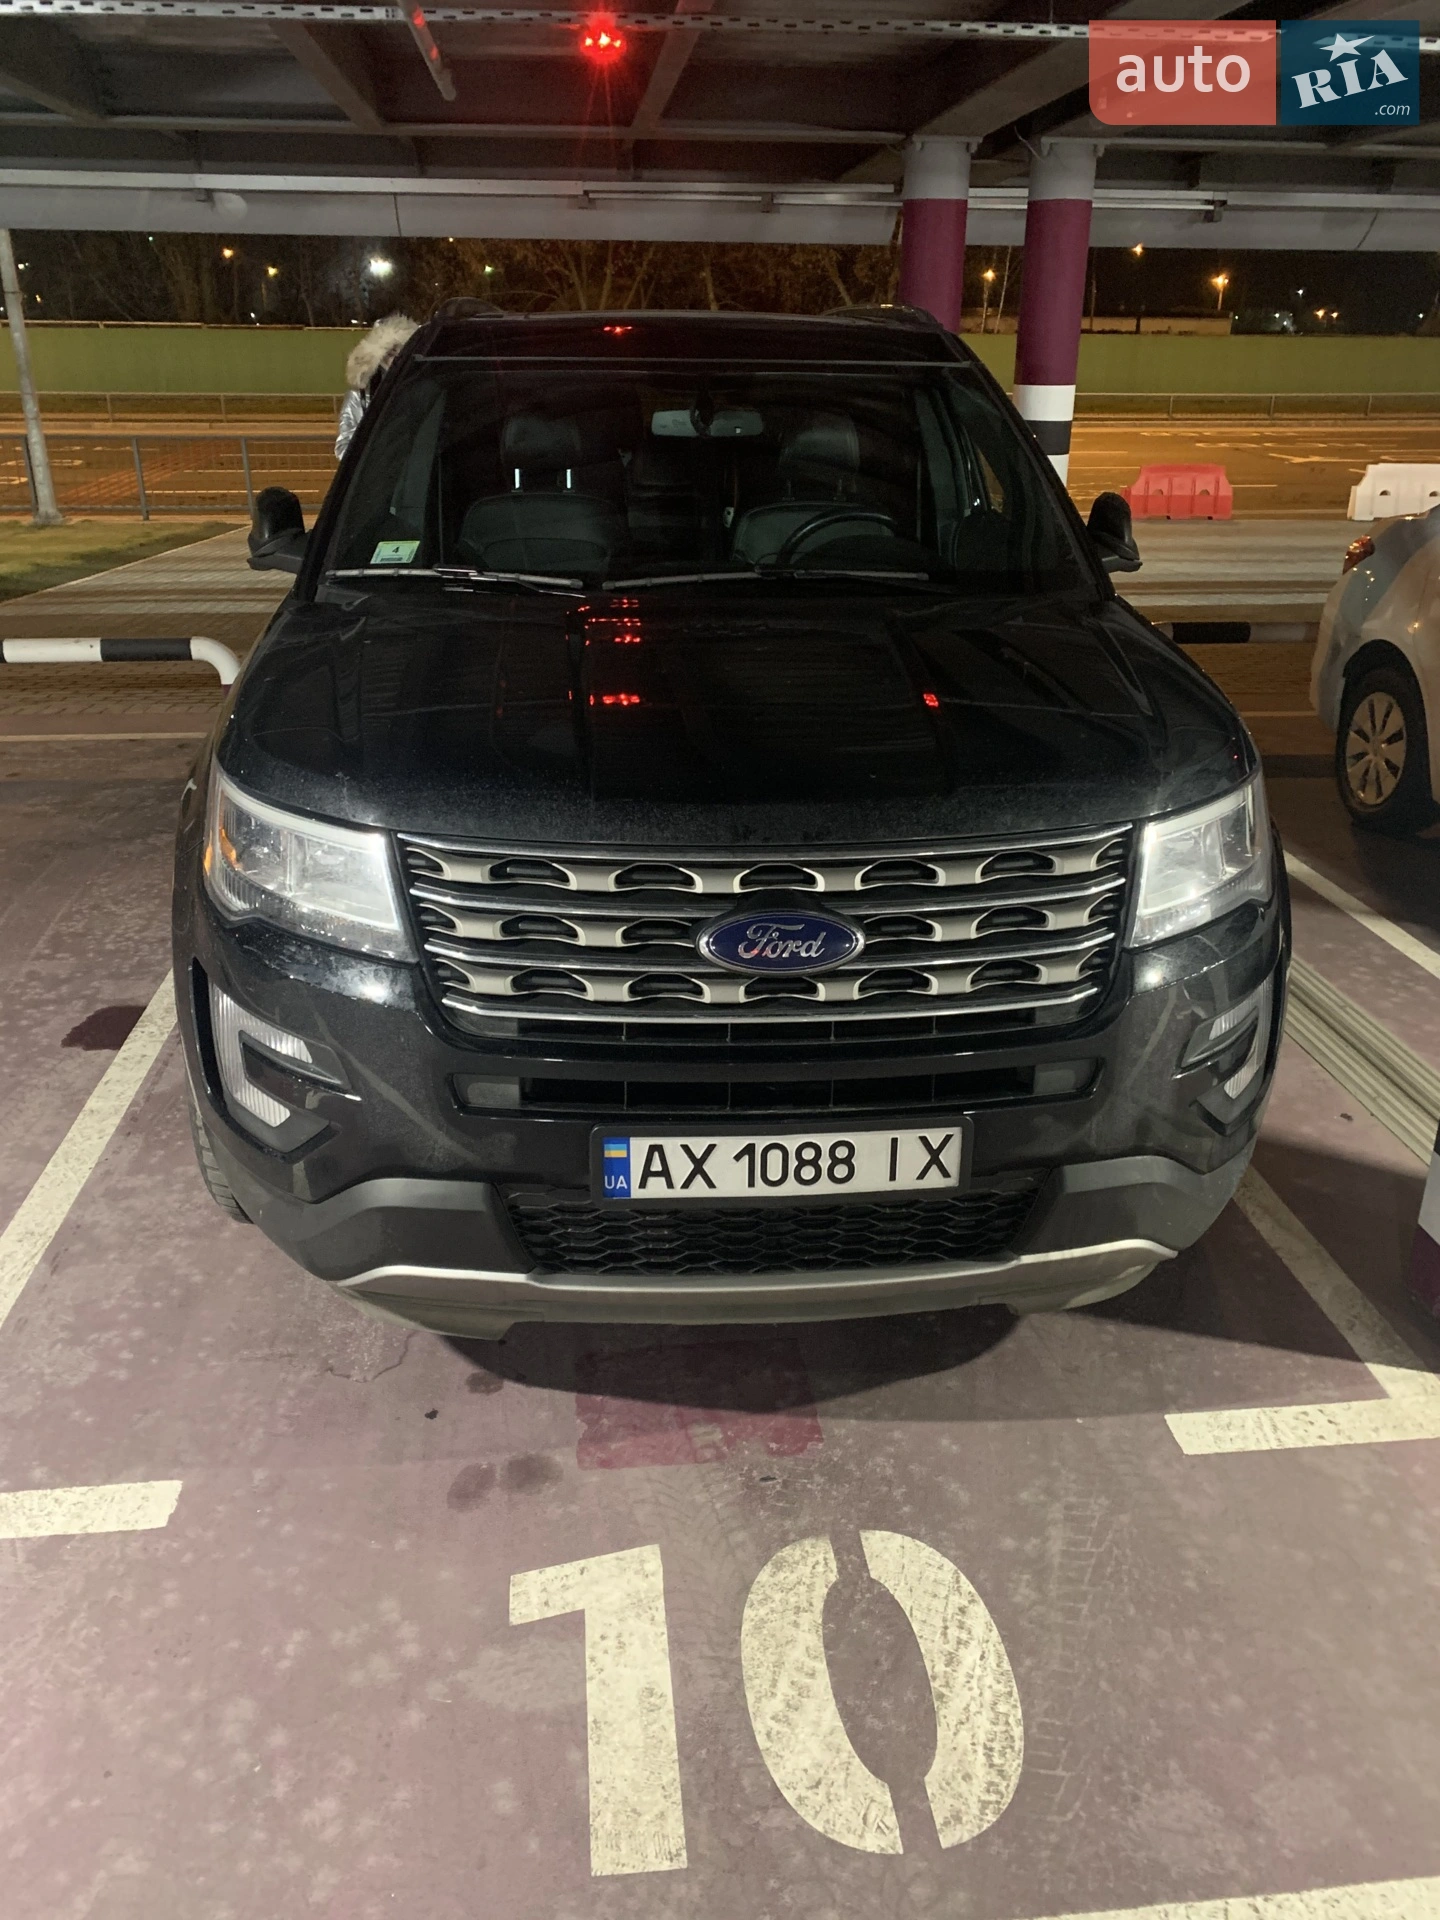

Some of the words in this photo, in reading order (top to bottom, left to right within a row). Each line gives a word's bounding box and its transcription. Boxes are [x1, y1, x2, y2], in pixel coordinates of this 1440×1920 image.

[737, 922, 827, 960] Ford
[604, 1175, 628, 1190] UA
[637, 1142, 718, 1190] AX
[733, 1139, 856, 1188] 1088
[508, 1529, 1025, 1877] 10
